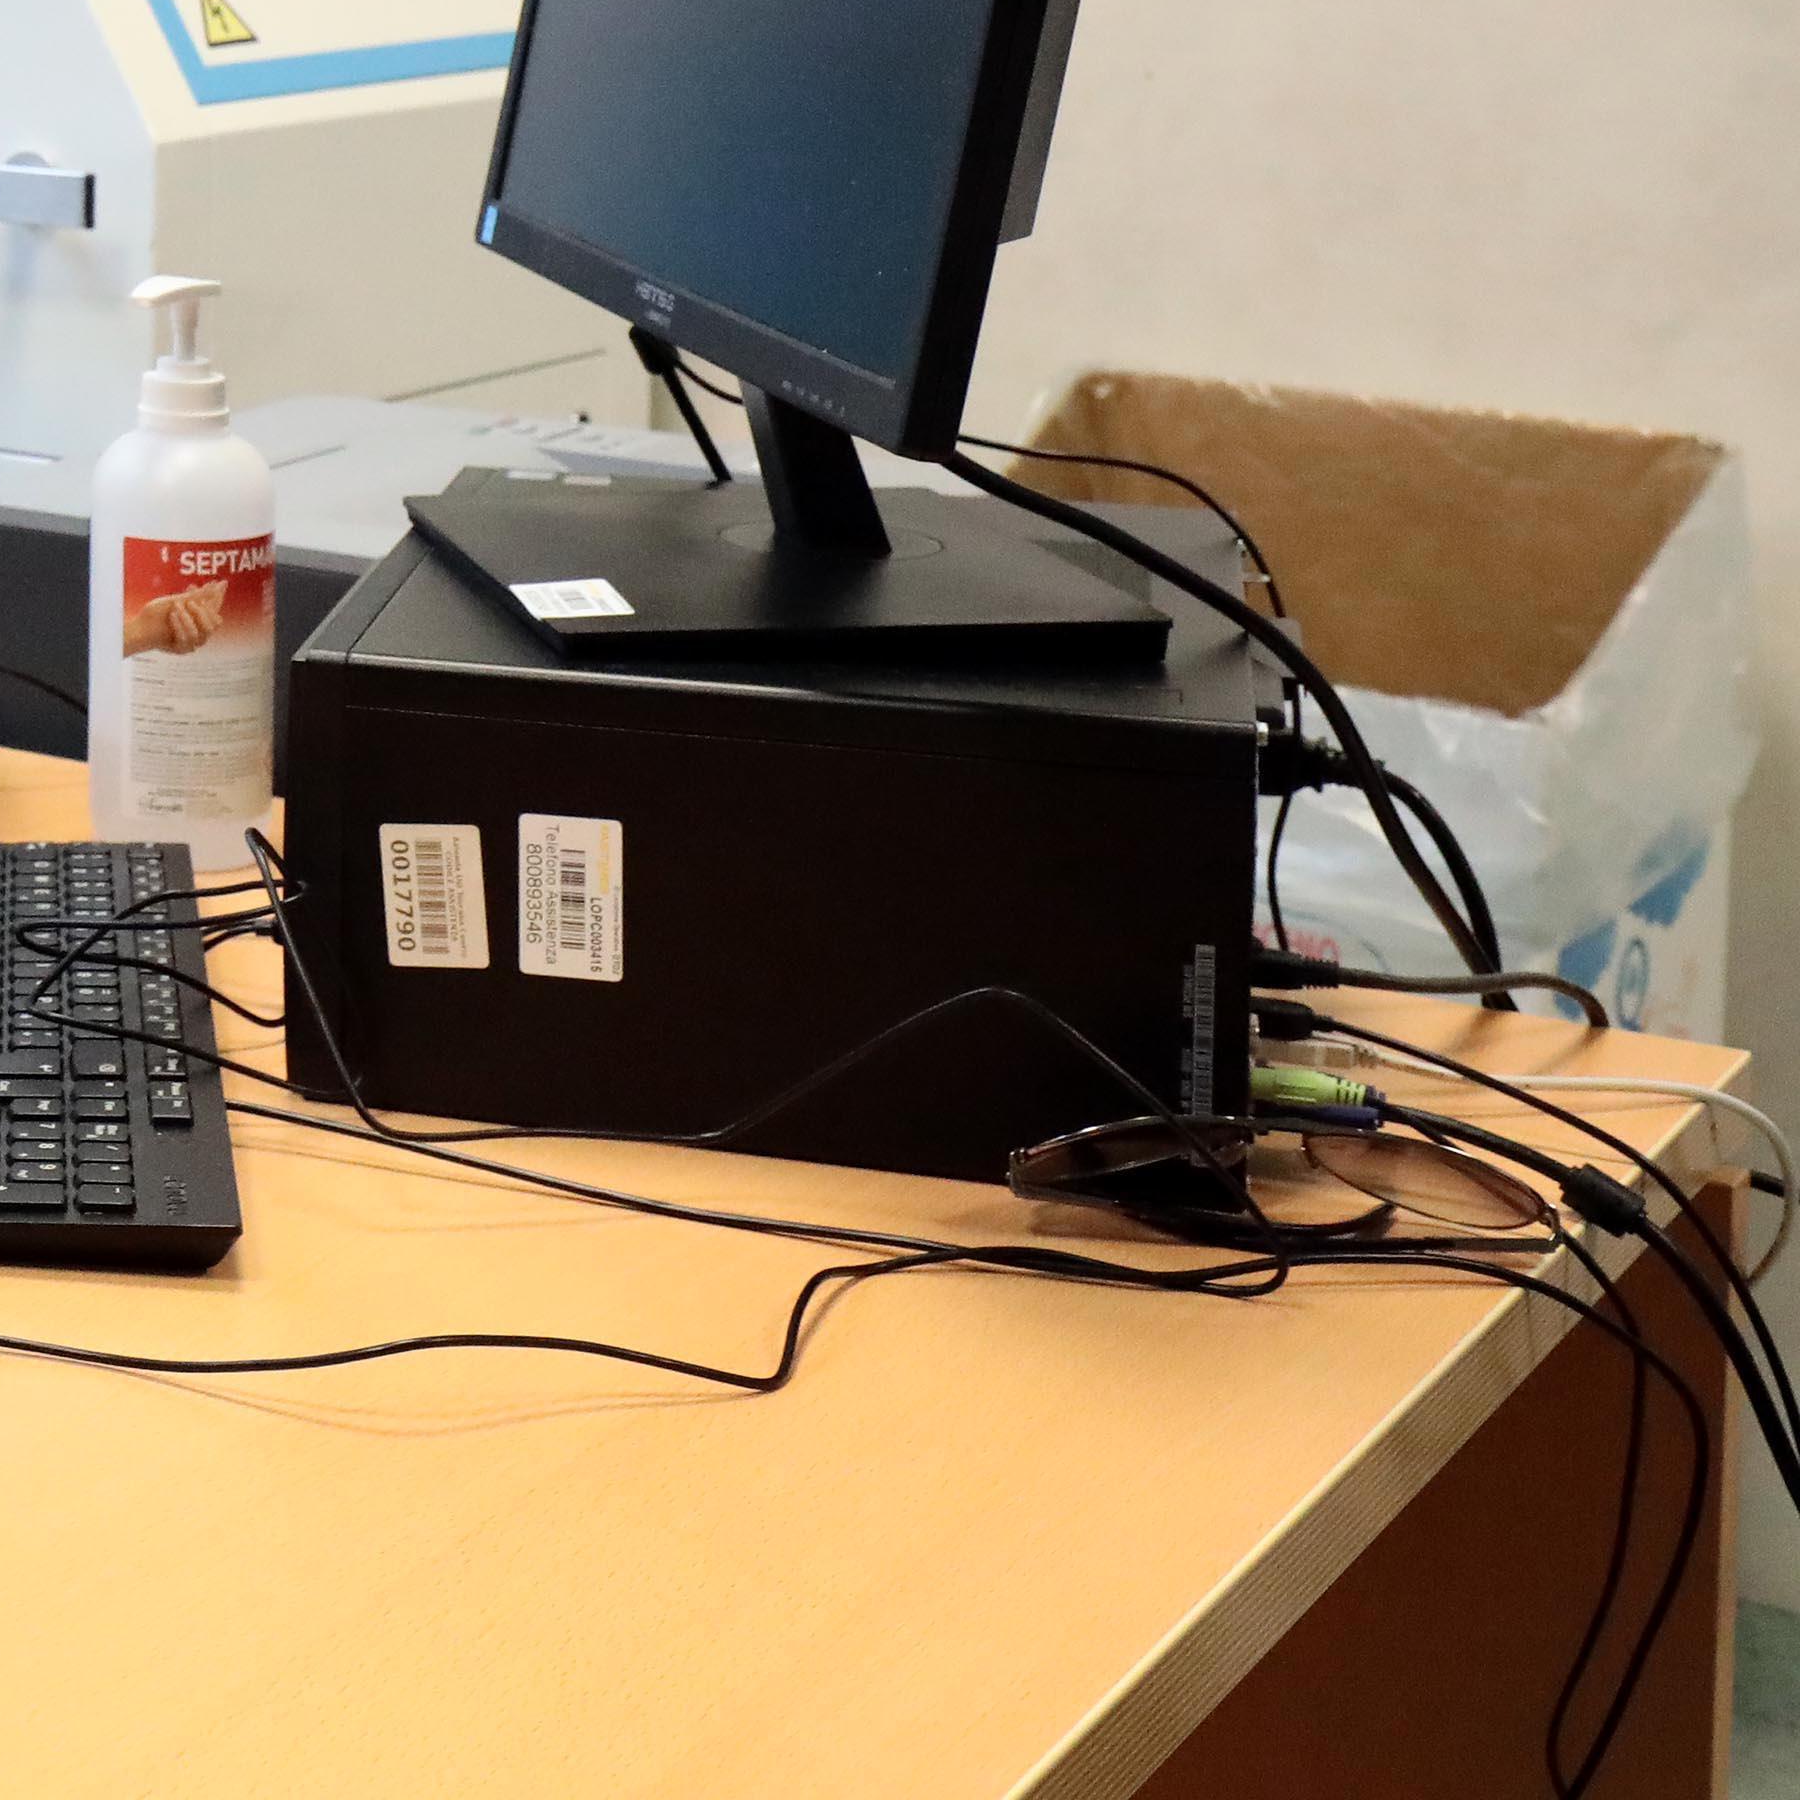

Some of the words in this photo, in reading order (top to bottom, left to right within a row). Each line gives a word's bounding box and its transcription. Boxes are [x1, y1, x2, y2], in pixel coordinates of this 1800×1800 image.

[389, 839, 417, 952] 0017790
[526, 843, 543, 944] 800893546
[545, 824, 561, 886] Telefono
[546, 889, 560, 965] Assistenza
